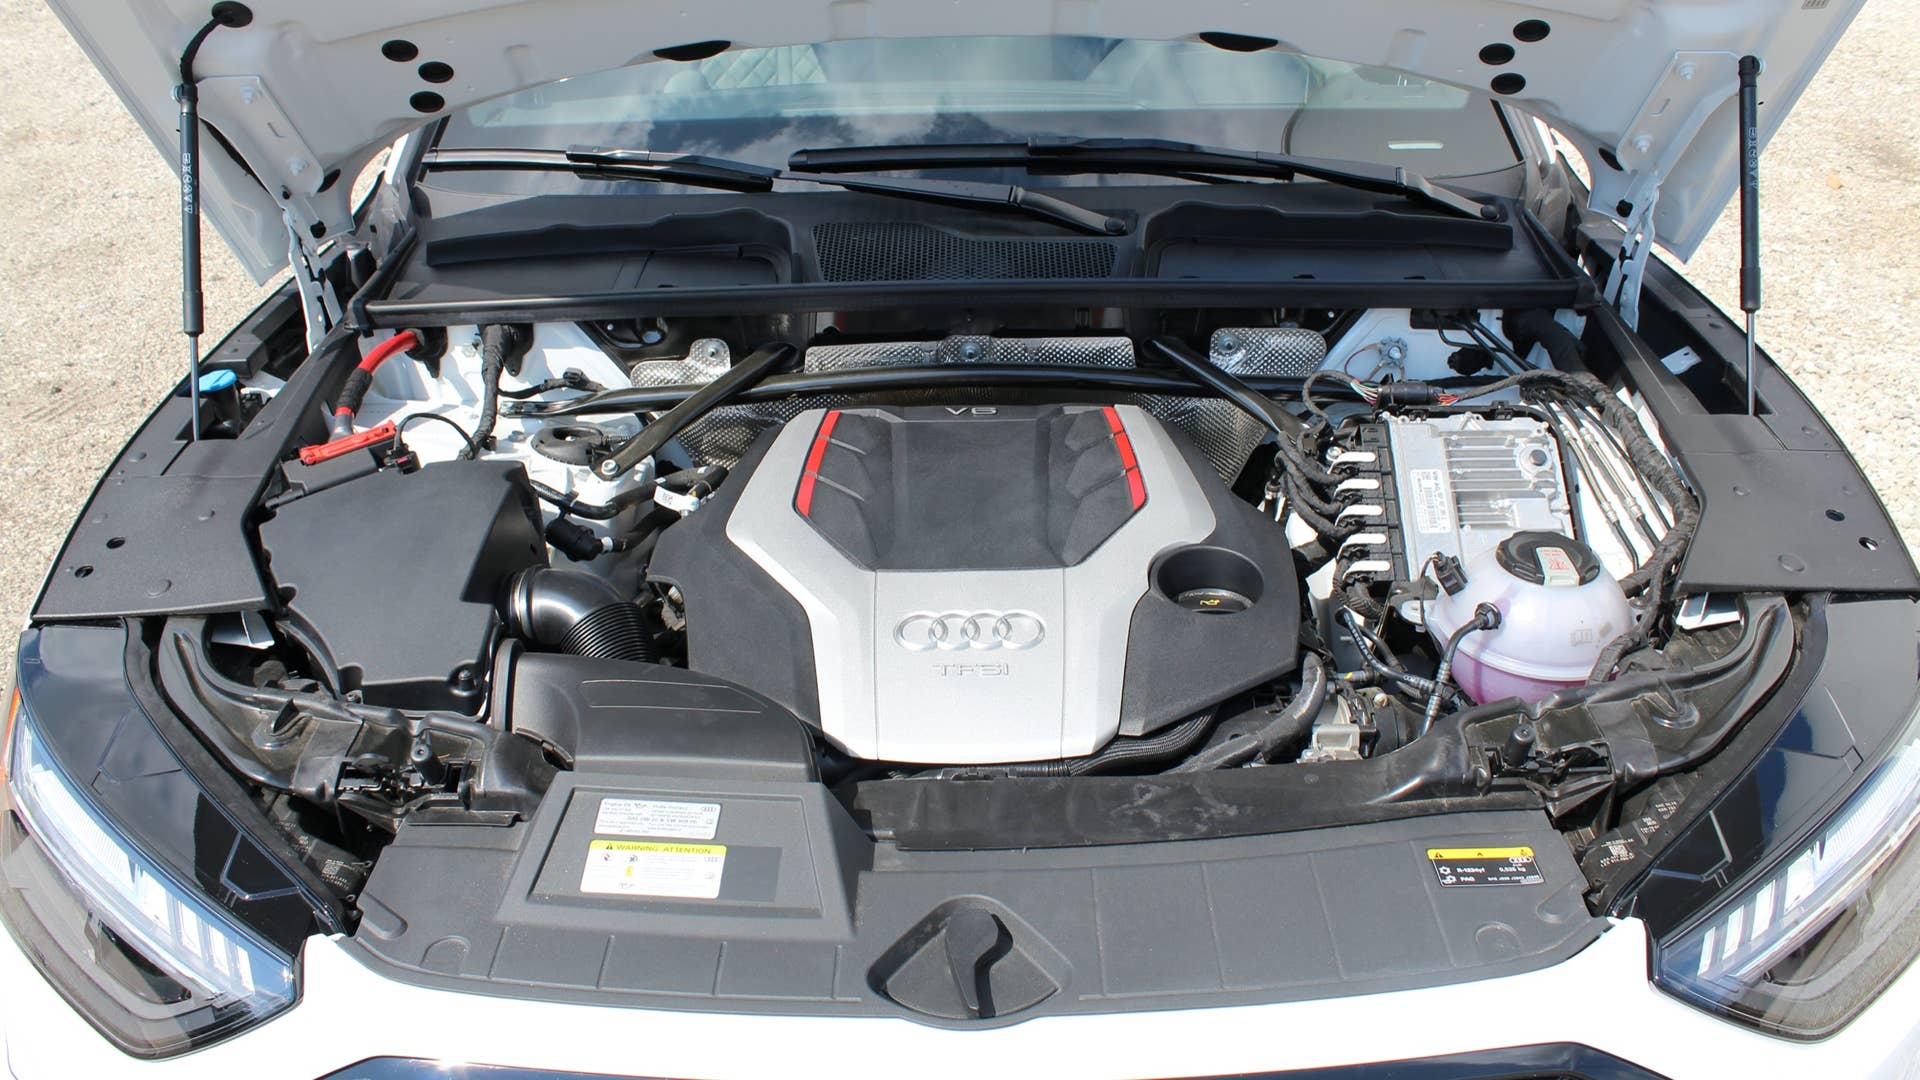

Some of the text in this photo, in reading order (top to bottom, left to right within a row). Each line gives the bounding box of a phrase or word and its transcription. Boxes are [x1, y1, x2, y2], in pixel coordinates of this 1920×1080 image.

[945, 407, 997, 416] V6
[932, 663, 1009, 677] TFSI
[616, 844, 711, 854] WARNING ATTENTION
